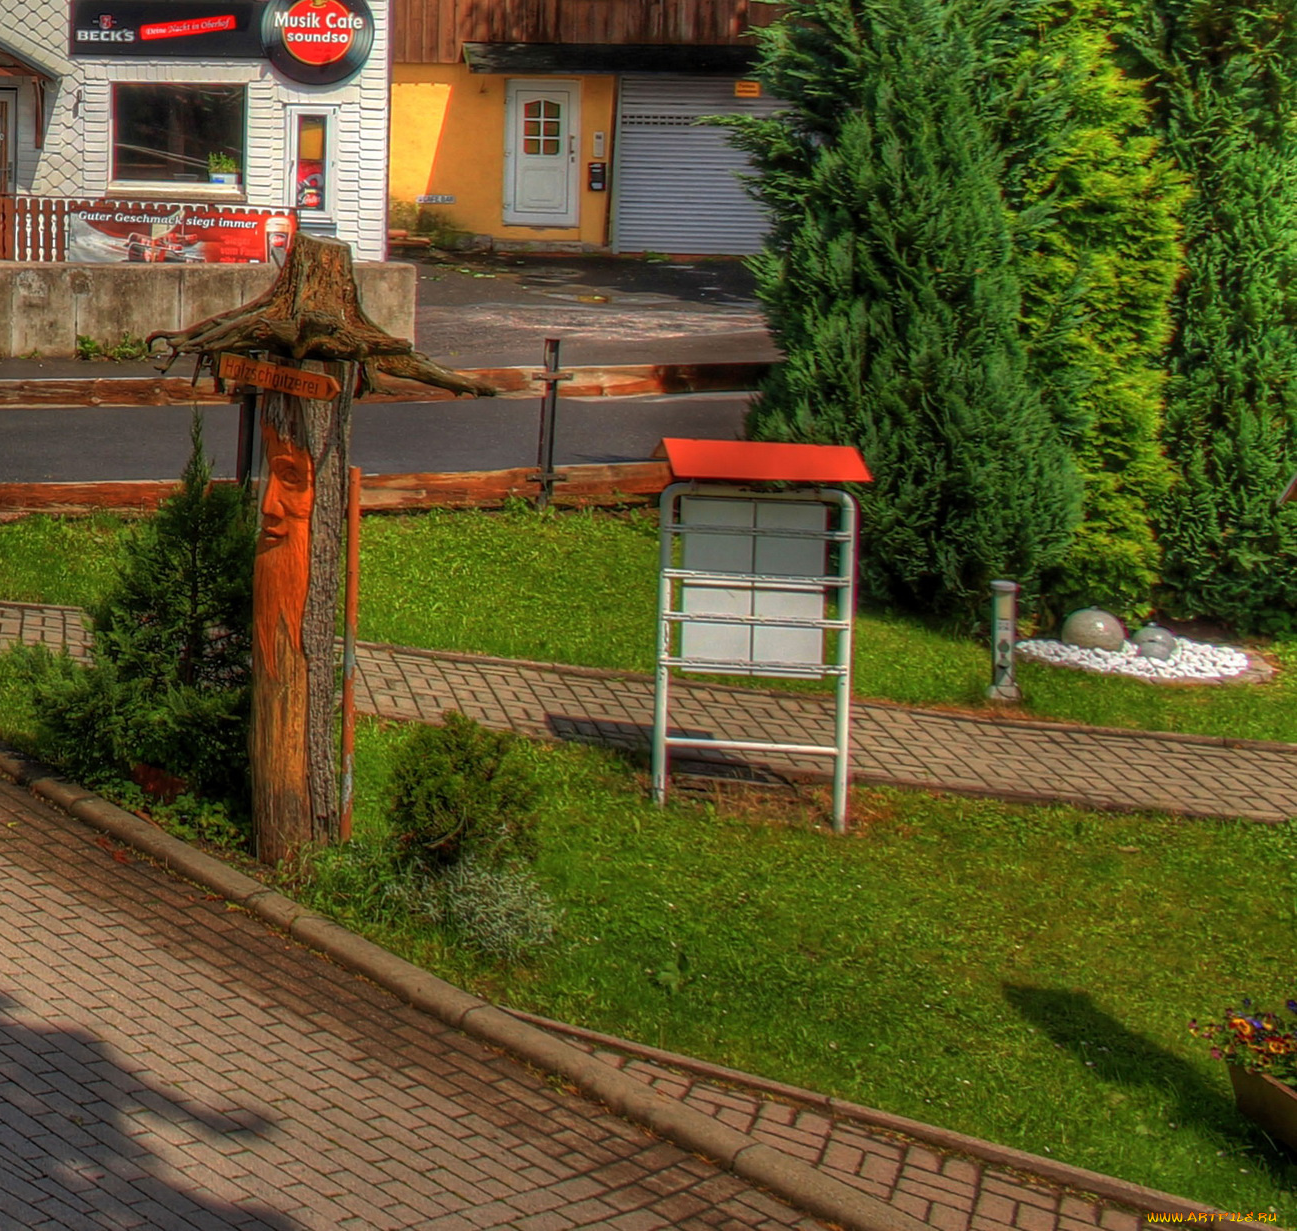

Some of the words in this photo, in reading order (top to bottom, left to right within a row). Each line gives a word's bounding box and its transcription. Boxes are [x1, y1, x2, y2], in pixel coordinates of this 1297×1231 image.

[200, 18, 230, 30] Oberhof
[274, 11, 320, 28] Musik
[326, 12, 363, 29] Cafe
[287, 31, 348, 43] soundso
[78, 210, 112, 222] Guter
[114, 212, 182, 225] Geschmack
[186, 216, 215, 229] siegt
[218, 217, 258, 229] immer
[225, 357, 320, 396] Holzschnitzerei
